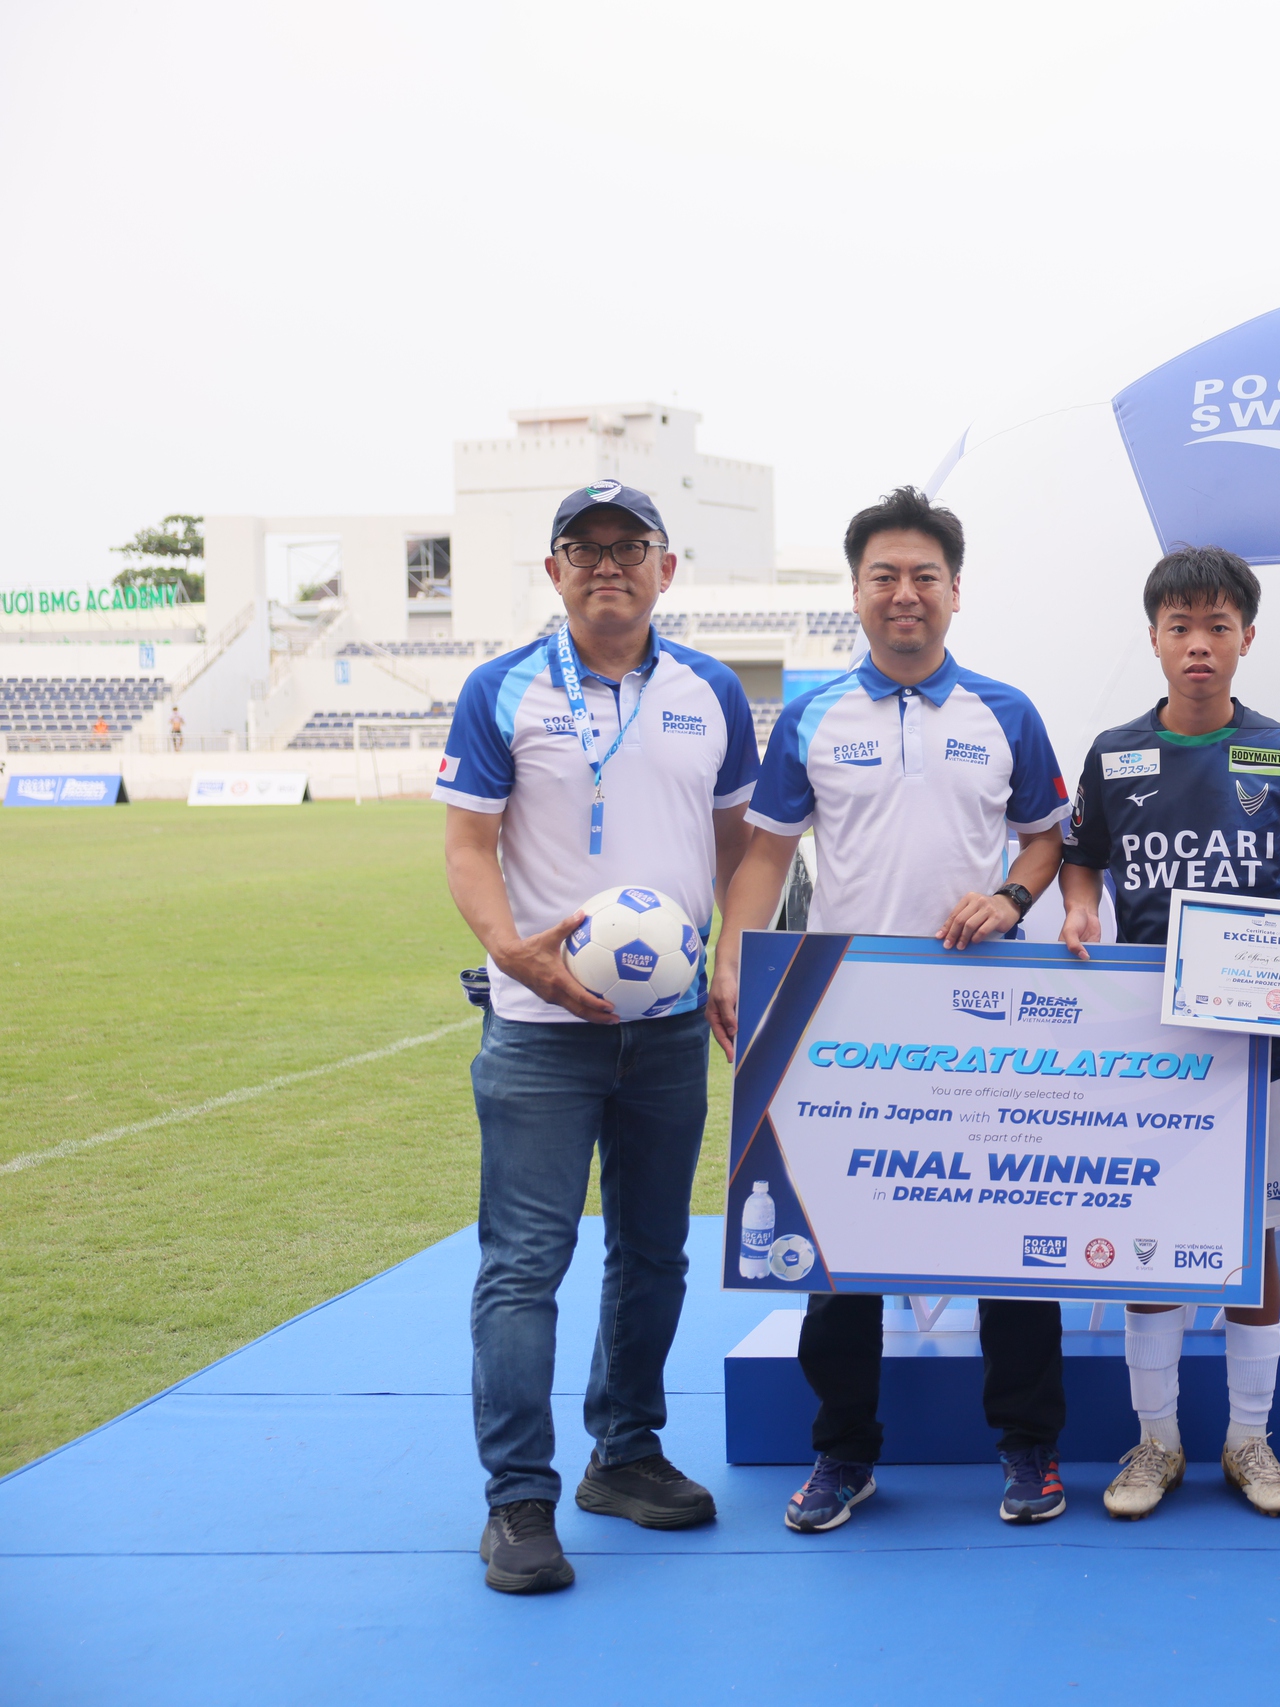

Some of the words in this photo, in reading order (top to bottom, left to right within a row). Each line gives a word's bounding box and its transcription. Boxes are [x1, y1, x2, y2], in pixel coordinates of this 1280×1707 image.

[40, 591, 80, 612] BMG
[86, 583, 178, 611] ACADEMY
[558, 622, 574, 664] OJECT
[562, 666, 583, 701] 2025
[543, 712, 594, 725] POCI
[662, 710, 702, 724] DREAM
[662, 722, 707, 736] PROJECT
[834, 740, 878, 754] POCARI
[946, 738, 986, 752] DREAM
[834, 748, 874, 762] SWEAT
[944, 749, 990, 766] PROJECT
[1106, 763, 1157, 777] ワークスタッフ
[1122, 830, 1274, 862] POCARI
[1124, 860, 1263, 890] SWEAT
[622, 952, 652, 962] POCARI
[1221, 968, 1252, 978] FINAL
[953, 990, 1004, 1000] POCARI
[1021, 991, 1078, 1007] DREAM
[953, 999, 999, 1008] SWEAT
[1018, 1007, 1082, 1024] PROJECT
[808, 1040, 1214, 1080] CONGRATULATION
[931, 1086, 950, 1096] You
[953, 1088, 972, 1097] are
[975, 1086, 1022, 1100] officially
[1024, 1088, 1068, 1100] selected
[1072, 1090, 1084, 1100] to
[797, 1101, 852, 1118] Train
[858, 1102, 879, 1119] in
[884, 1104, 953, 1125] Japan
[960, 1110, 990, 1124] with
[998, 1108, 1128, 1128] TOKUSHIMA
[1136, 1112, 1215, 1131] VORTIS
[968, 1134, 980, 1142] as
[982, 1132, 1008, 1146] part
[1009, 1131, 1022, 1144] of
[1024, 1132, 1042, 1144] the
[846, 1148, 972, 1180] FINAL
[988, 1153, 1161, 1187] WINNER
[872, 1189, 887, 1201] in
[892, 1186, 974, 1204] DREAM
[978, 1188, 1078, 1207] PROJECT
[1081, 1192, 1133, 1208] 2025
[1024, 1238, 1066, 1248] POCARI
[1024, 1246, 1062, 1255] SWEAT
[1174, 1250, 1223, 1269] BMG
